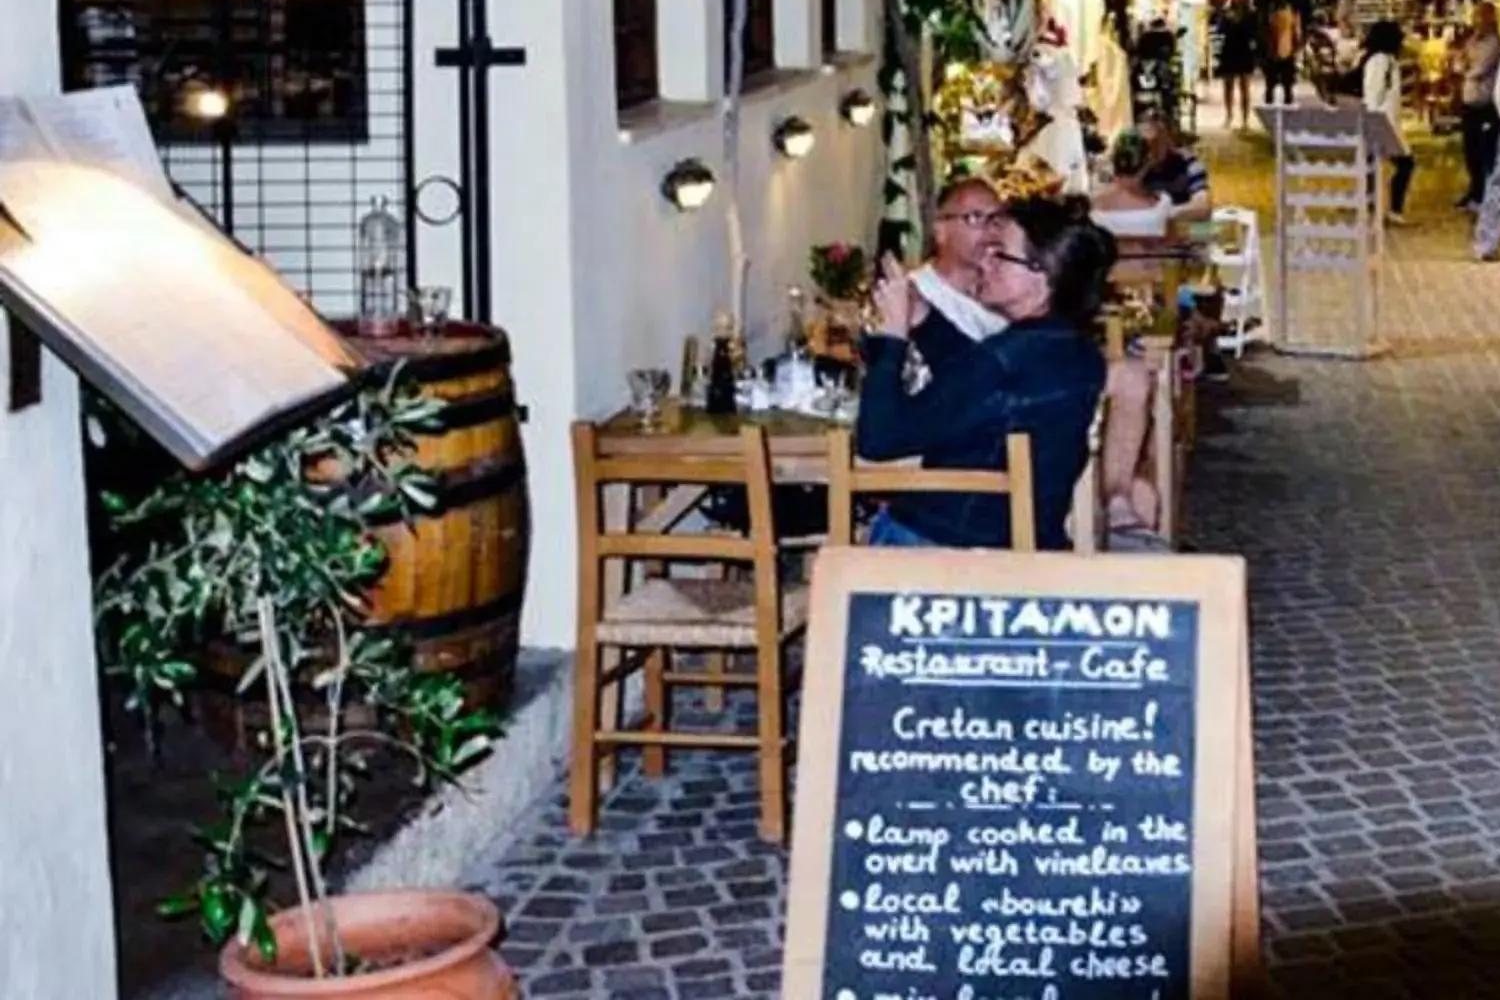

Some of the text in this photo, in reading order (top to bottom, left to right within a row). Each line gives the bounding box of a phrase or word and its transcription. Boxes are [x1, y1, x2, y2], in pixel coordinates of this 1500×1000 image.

[860, 643, 1049, 679] Restaurant
[1080, 647, 1169, 682] Cafe
[893, 701, 1158, 741] Cretan cuisine!
[849, 748, 1182, 781] recommended by the
[967, 816, 1085, 846] cooked
[1101, 820, 1128, 844] in
[1137, 815, 1188, 843] the
[864, 846, 1192, 877] oven with vineleaves
[864, 882, 961, 914] local
[864, 918, 1150, 951] with vegetables
[859, 945, 1170, 979] and local cheese
